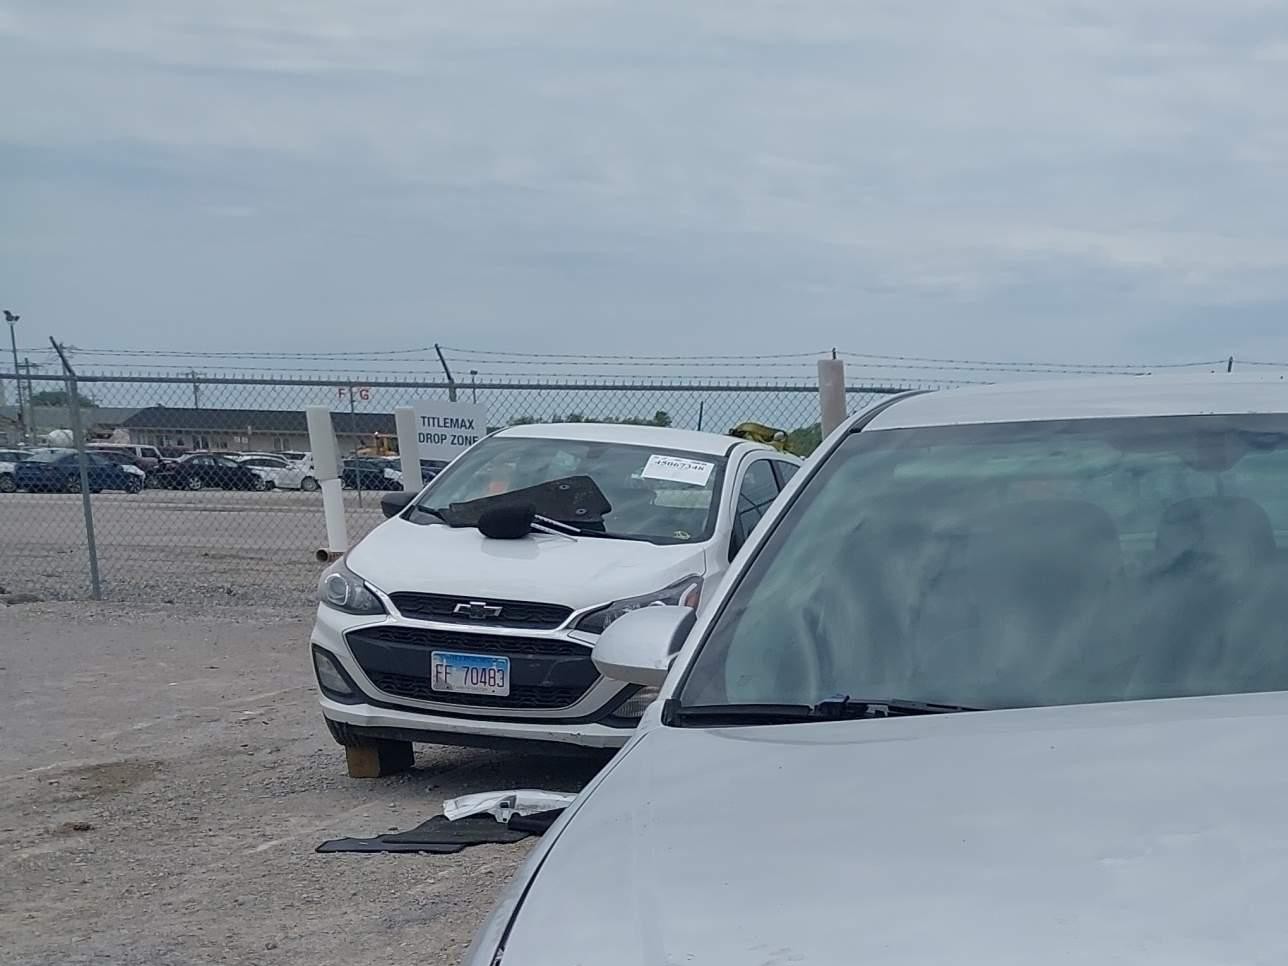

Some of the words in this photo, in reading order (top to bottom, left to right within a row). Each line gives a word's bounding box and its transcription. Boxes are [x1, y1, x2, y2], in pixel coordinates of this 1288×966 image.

[359, 389, 369, 401] G
[420, 416, 475, 430] TITLEMAX
[418, 432, 447, 445] DROP
[462, 665, 505, 688] 70483
